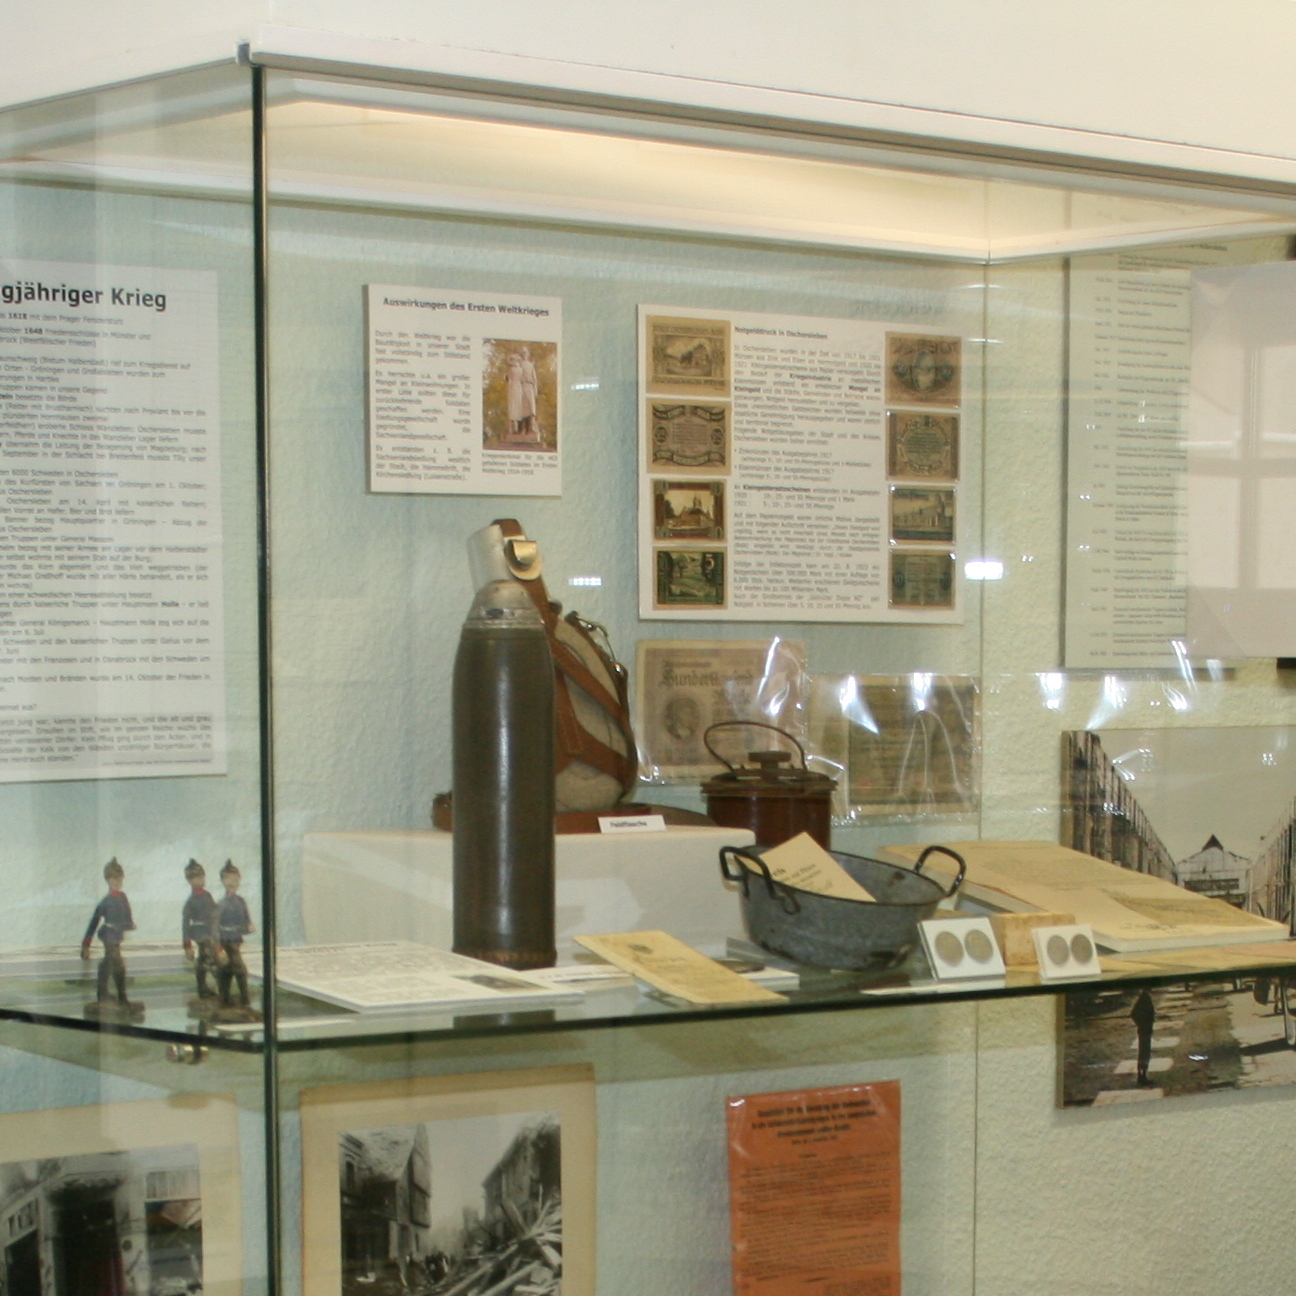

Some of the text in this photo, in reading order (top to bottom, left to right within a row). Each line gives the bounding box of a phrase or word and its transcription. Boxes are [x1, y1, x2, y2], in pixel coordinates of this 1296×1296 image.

[111, 287, 167, 312] Krieg
[383, 297, 550, 317] Auswirkungen des Ersten Weltkrieges
